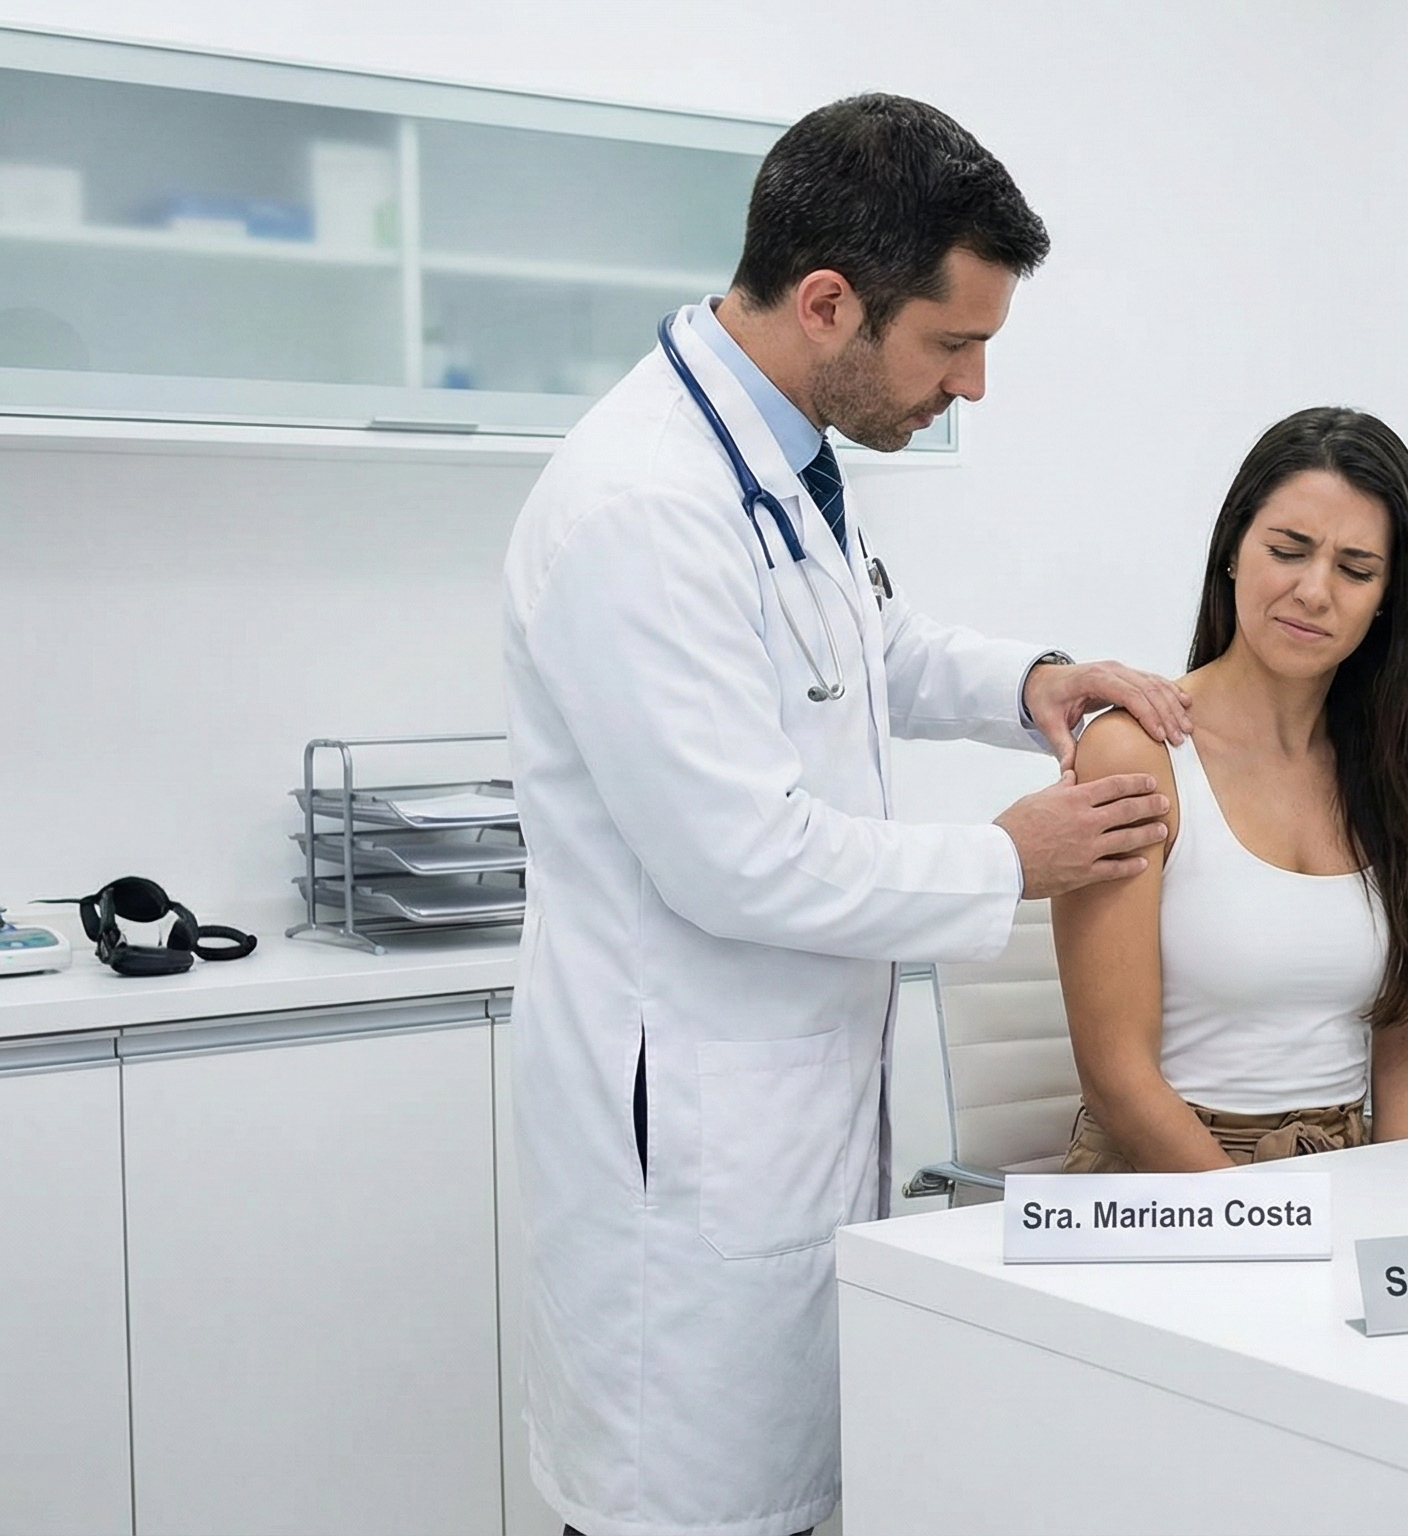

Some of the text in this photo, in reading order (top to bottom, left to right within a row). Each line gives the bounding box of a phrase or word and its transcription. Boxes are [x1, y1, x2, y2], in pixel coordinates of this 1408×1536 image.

[1021, 1198, 1313, 1230] Sra. Mariana Costa
